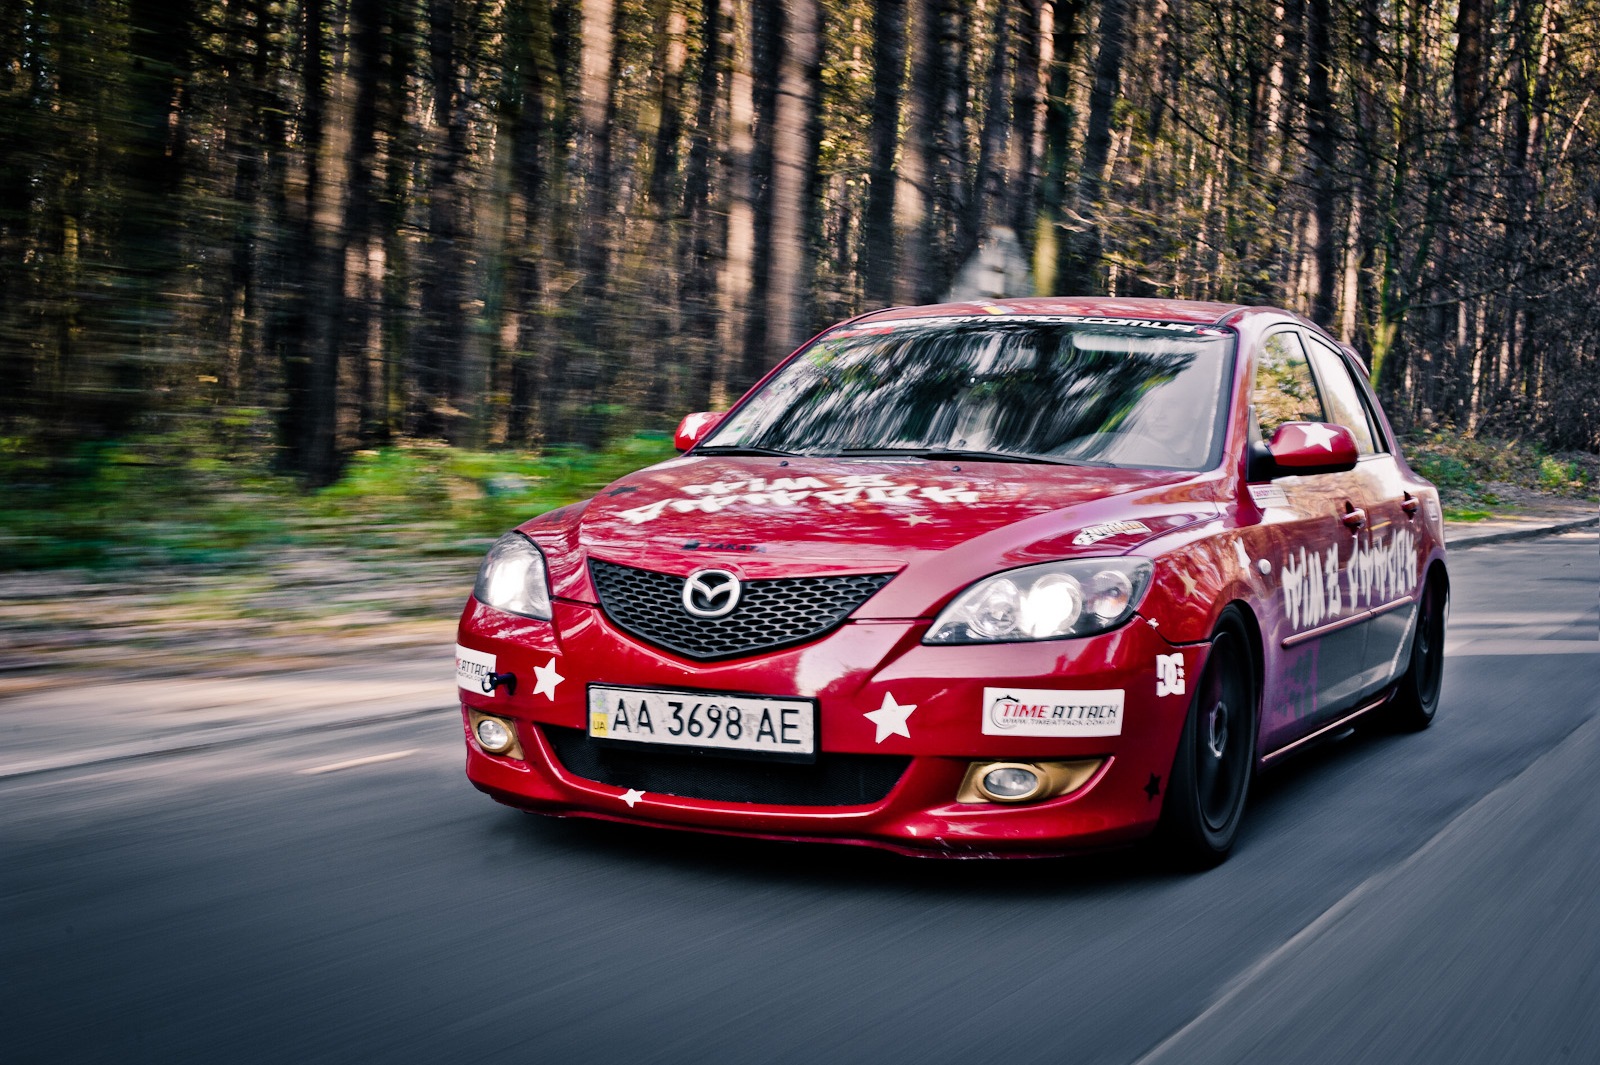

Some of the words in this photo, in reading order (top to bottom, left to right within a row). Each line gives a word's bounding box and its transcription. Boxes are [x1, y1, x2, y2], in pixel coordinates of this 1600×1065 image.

[616, 486, 980, 525] ATTACK
[612, 698, 655, 735] AA
[667, 701, 744, 741] 3698
[755, 707, 803, 745] AE
[1002, 703, 1051, 719] TIME
[1051, 704, 1120, 719] ATTACK
[592, 720, 607, 731] UA
